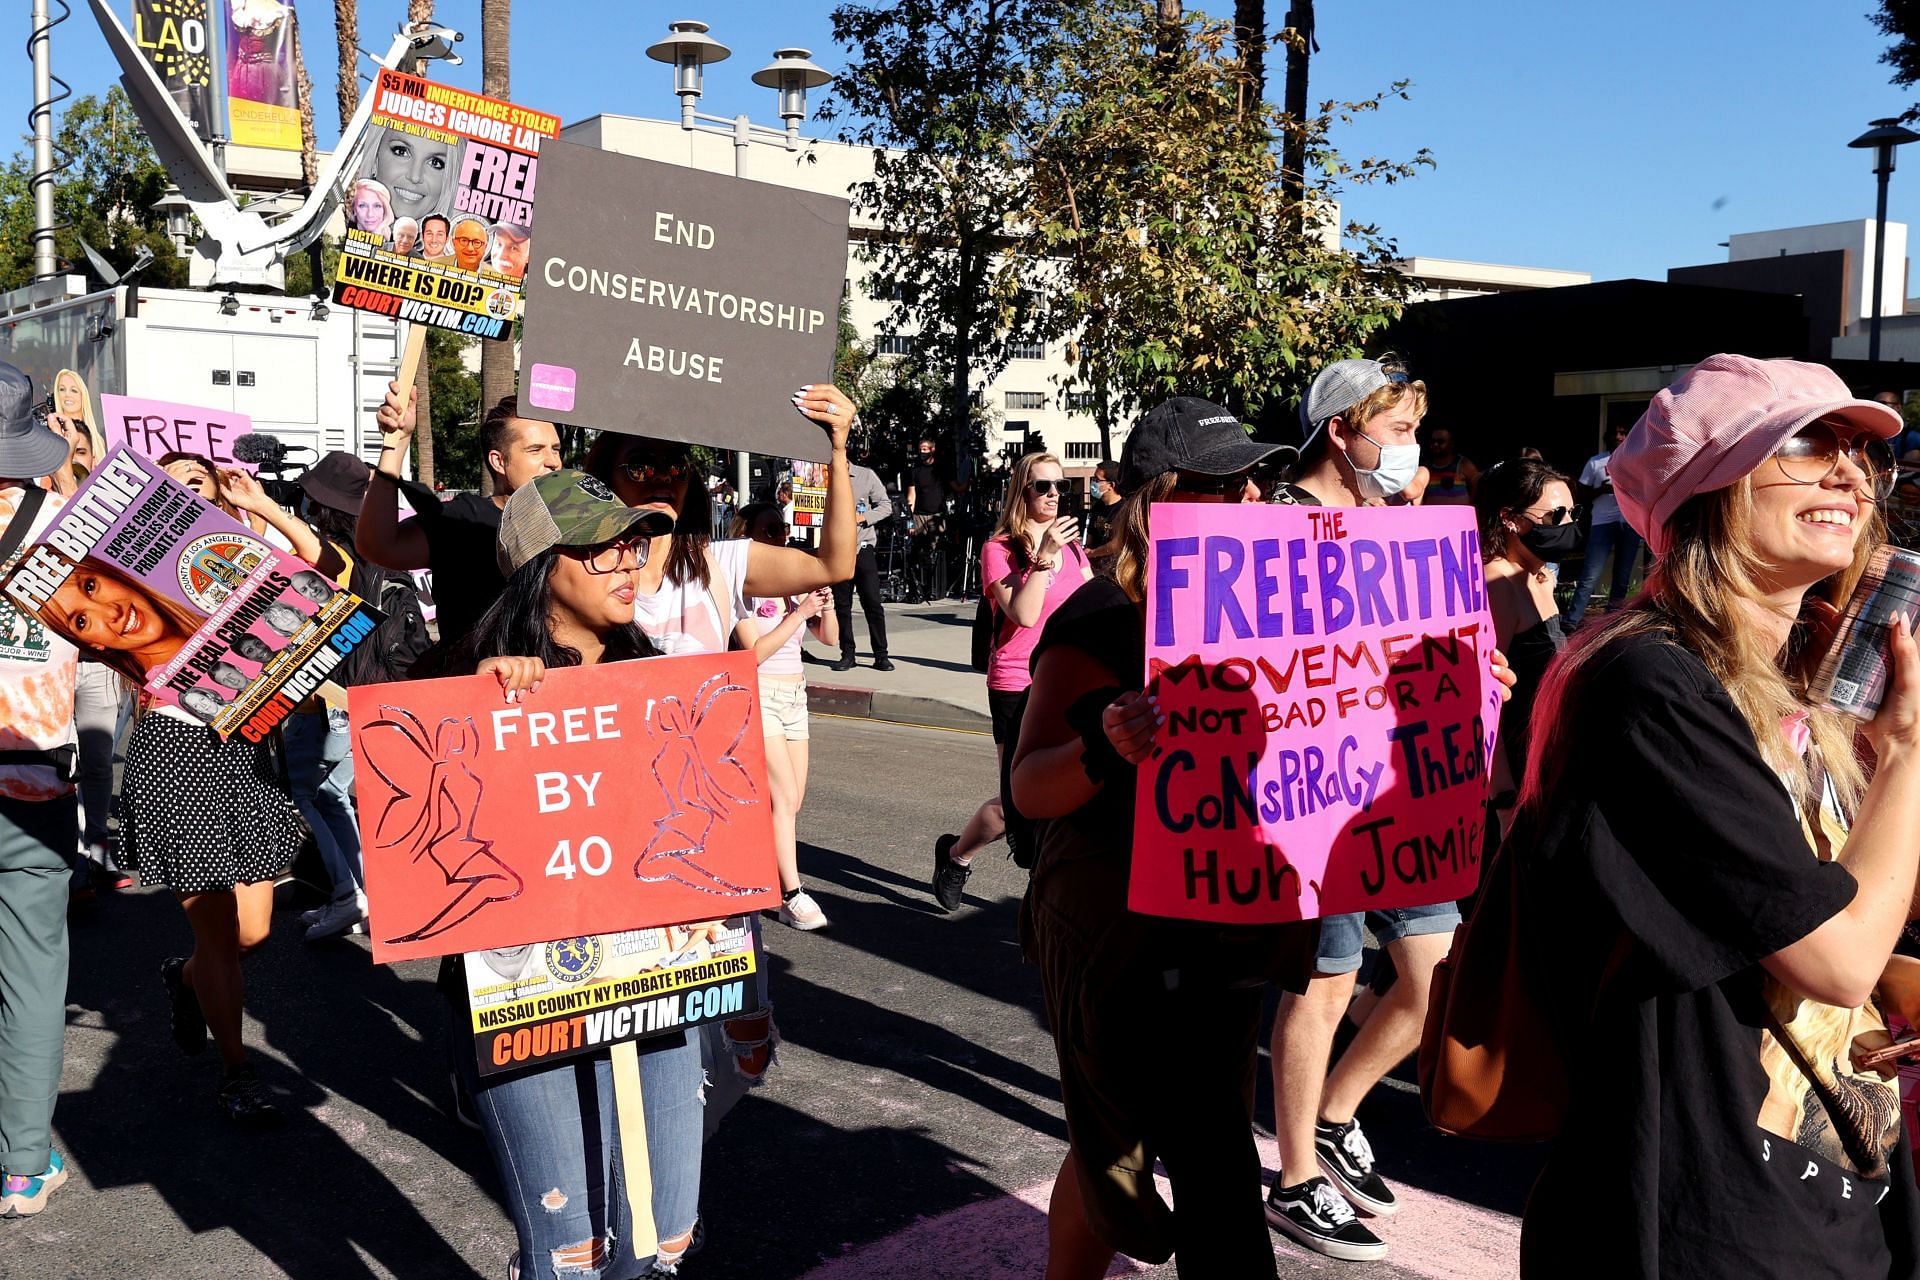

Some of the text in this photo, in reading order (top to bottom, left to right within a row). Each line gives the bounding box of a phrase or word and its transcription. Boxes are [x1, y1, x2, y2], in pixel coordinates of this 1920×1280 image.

[233, 109, 297, 122] CINDERELLA
[371, 115, 459, 146] NOT THE ONLY VICTIM!
[378, 90, 551, 153] JUDGES IGNORE LA
[382, 73, 556, 134] $5 MIL INHERITANCE STOLEN
[348, 227, 384, 247] VICTIM
[654, 211, 715, 250] END
[344, 256, 413, 291] WHERE
[414, 273, 433, 297] IS
[437, 280, 484, 306] DOJ?
[543, 256, 825, 334] CONSERVATORSHIP
[341, 286, 504, 338] COURTVICTIM.COM
[623, 337, 724, 383] ABUSE
[123, 415, 233, 463] FREE
[5, 449, 153, 612] FREE BRITNEY
[104, 479, 177, 560] EXPOSE CORRUPT
[118, 490, 190, 569] LOS ANGELES COUNTY
[794, 494, 814, 508] WHERE
[814, 495, 820, 508] IS
[1307, 511, 1348, 541] THE
[133, 499, 206, 577] PROBATE COURT
[181, 535, 243, 595] COUNTY OF LOS ANGELES
[150, 673, 168, 690] HELP
[165, 633, 205, 677] #FREEBRITNEY
[254, 555, 281, 584] EXPOSE
[165, 667, 195, 695] THE
[187, 639, 230, 674] REAL
[215, 570, 292, 646] CRIMINALS
[27, 650, 48, 658] WINE
[222, 707, 250, 733] PROSECUTE
[247, 698, 259, 712] LOS
[256, 681, 276, 702] ANGELES
[272, 663, 293, 686] COUNTY
[290, 644, 314, 668] PROBATE
[309, 626, 328, 650] COURT
[325, 599, 356, 630] PREDATORS
[240, 610, 376, 743] COURTVICTIM.COM
[1149, 622, 1487, 697] MOVEMENT:
[491, 703, 621, 752] FREE
[1168, 672, 1461, 737] NOT BAD FOR A
[534, 771, 603, 814] BY
[544, 835, 613, 881] 40
[479, 956, 748, 1028] NASSAU COUNTY NY PROBATE PREDATORS
[492, 981, 744, 1066] COURTVICTIM.COM
